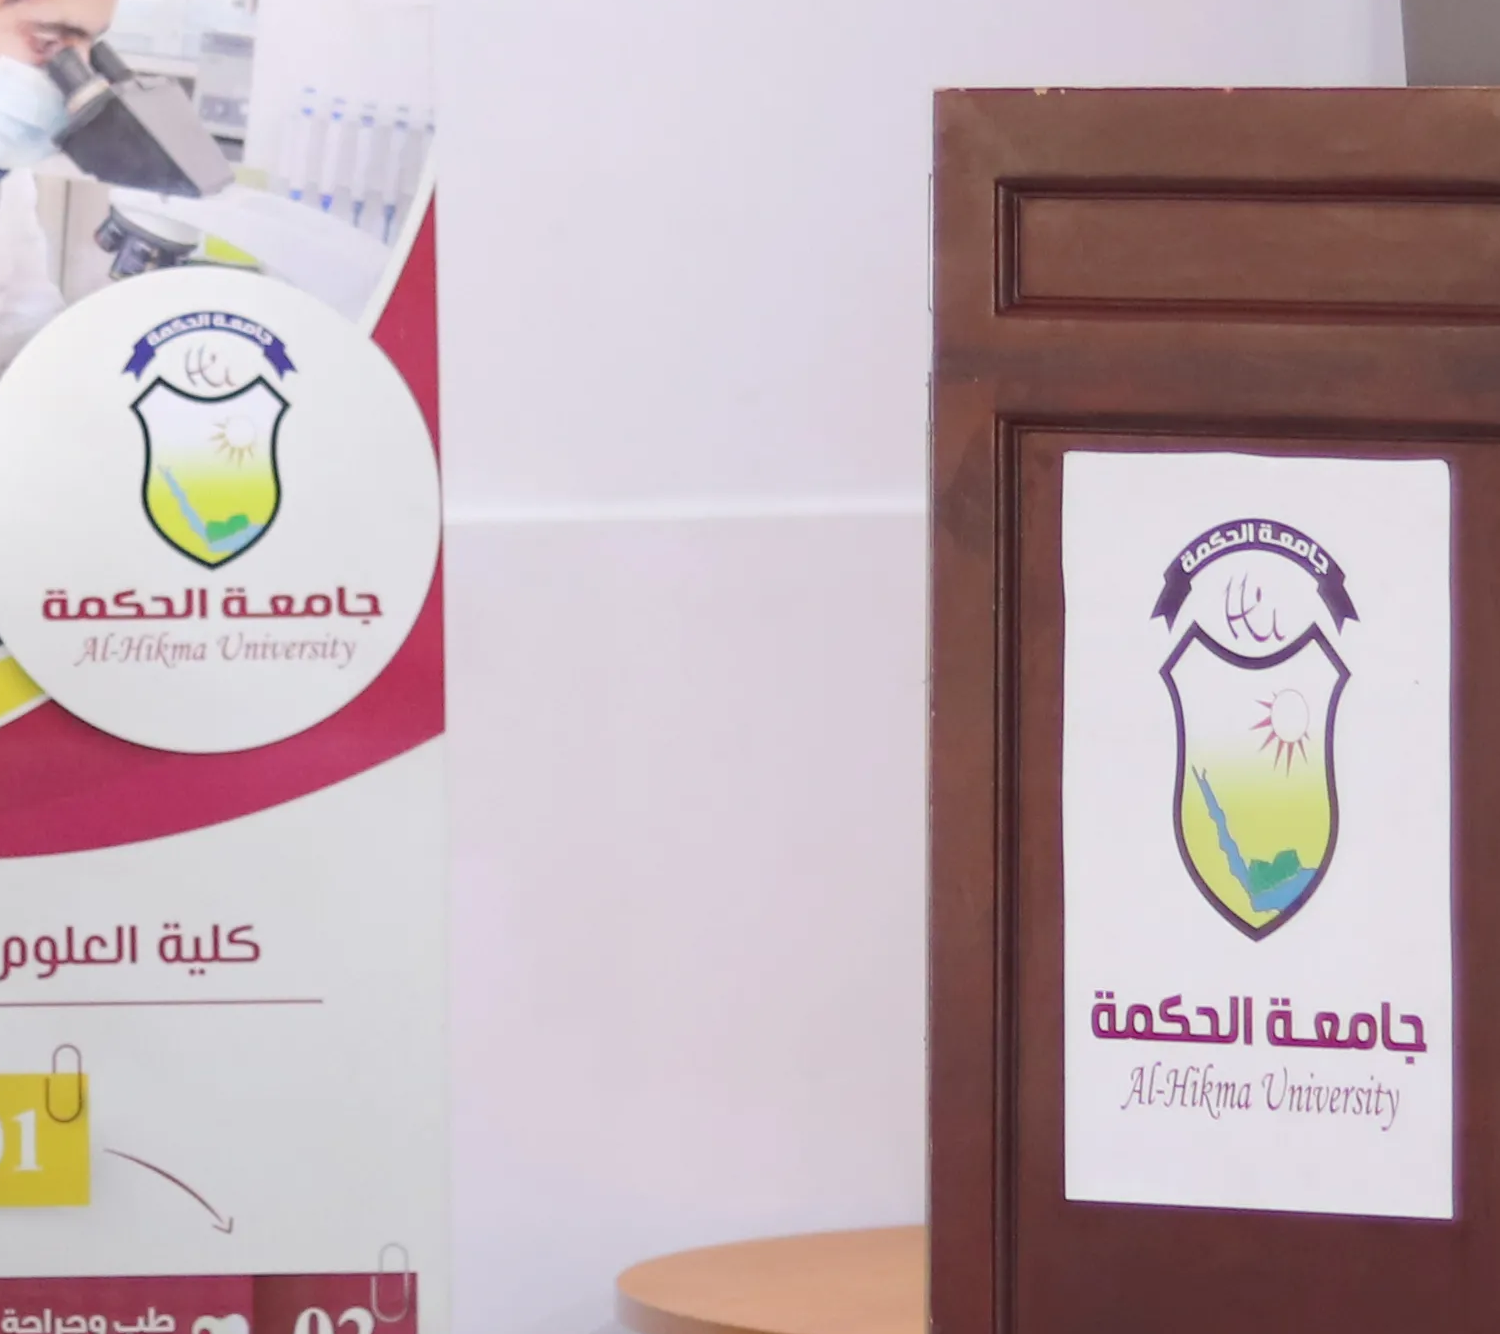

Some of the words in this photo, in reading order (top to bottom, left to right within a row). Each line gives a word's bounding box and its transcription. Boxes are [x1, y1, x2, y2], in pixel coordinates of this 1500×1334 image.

[146, 313, 211, 347] الحكمة
[212, 313, 274, 347] جامعة
[1179, 522, 1255, 574] الحكمة
[1257, 522, 1330, 576] جامعة
[42, 587, 209, 622] الحكمة
[221, 586, 383, 625] جامعة
[73, 633, 208, 668] Al-Hikma
[215, 632, 357, 670] University
[157, 922, 262, 977] كلية
[1090, 990, 1254, 1046] الحكمة
[1266, 996, 1428, 1065] جامعة
[1120, 1060, 1252, 1120] Al-Hikma
[1260, 1068, 1401, 1132] University
